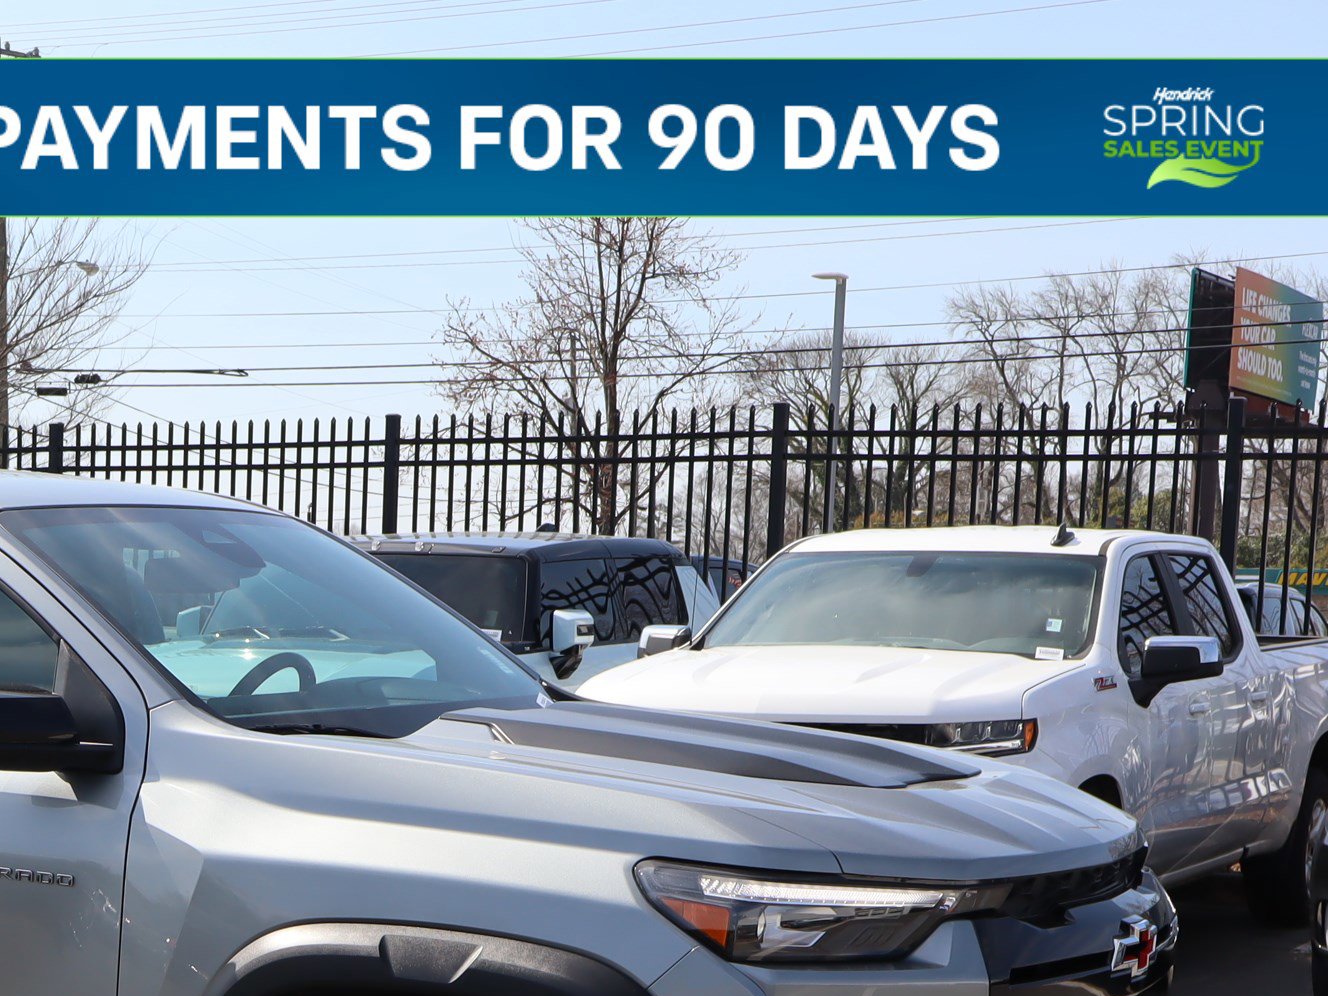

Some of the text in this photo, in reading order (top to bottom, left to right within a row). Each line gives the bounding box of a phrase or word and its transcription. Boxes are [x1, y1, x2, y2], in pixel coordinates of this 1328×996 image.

[1241, 287, 1258, 314] LIFE
[1240, 316, 1261, 345] YOUR
[1260, 326, 1277, 350] CAR
[1237, 346, 1267, 376] SHOULD
